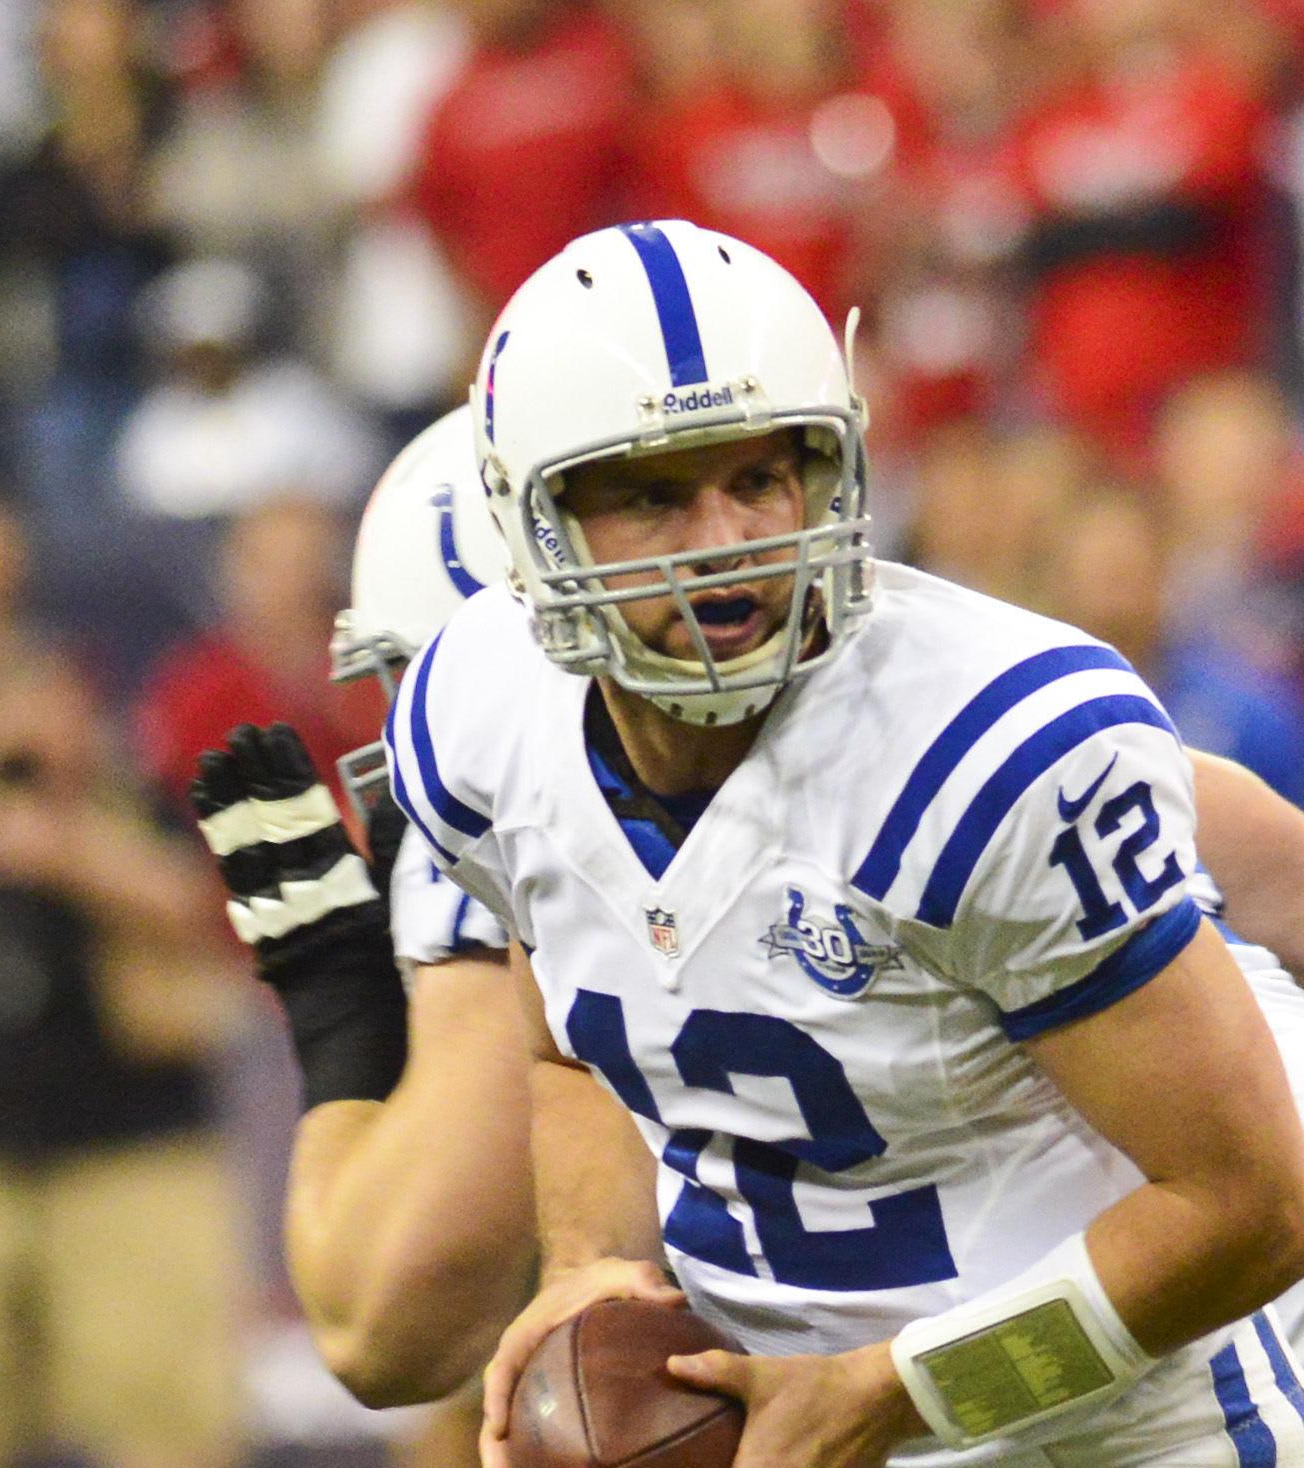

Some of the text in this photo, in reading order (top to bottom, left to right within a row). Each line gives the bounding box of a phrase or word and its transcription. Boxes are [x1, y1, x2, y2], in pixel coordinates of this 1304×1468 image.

[663, 387, 734, 414] Riddell
[1048, 780, 1186, 942] 12
[797, 920, 855, 967] 30
[566, 988, 959, 1292] 12
